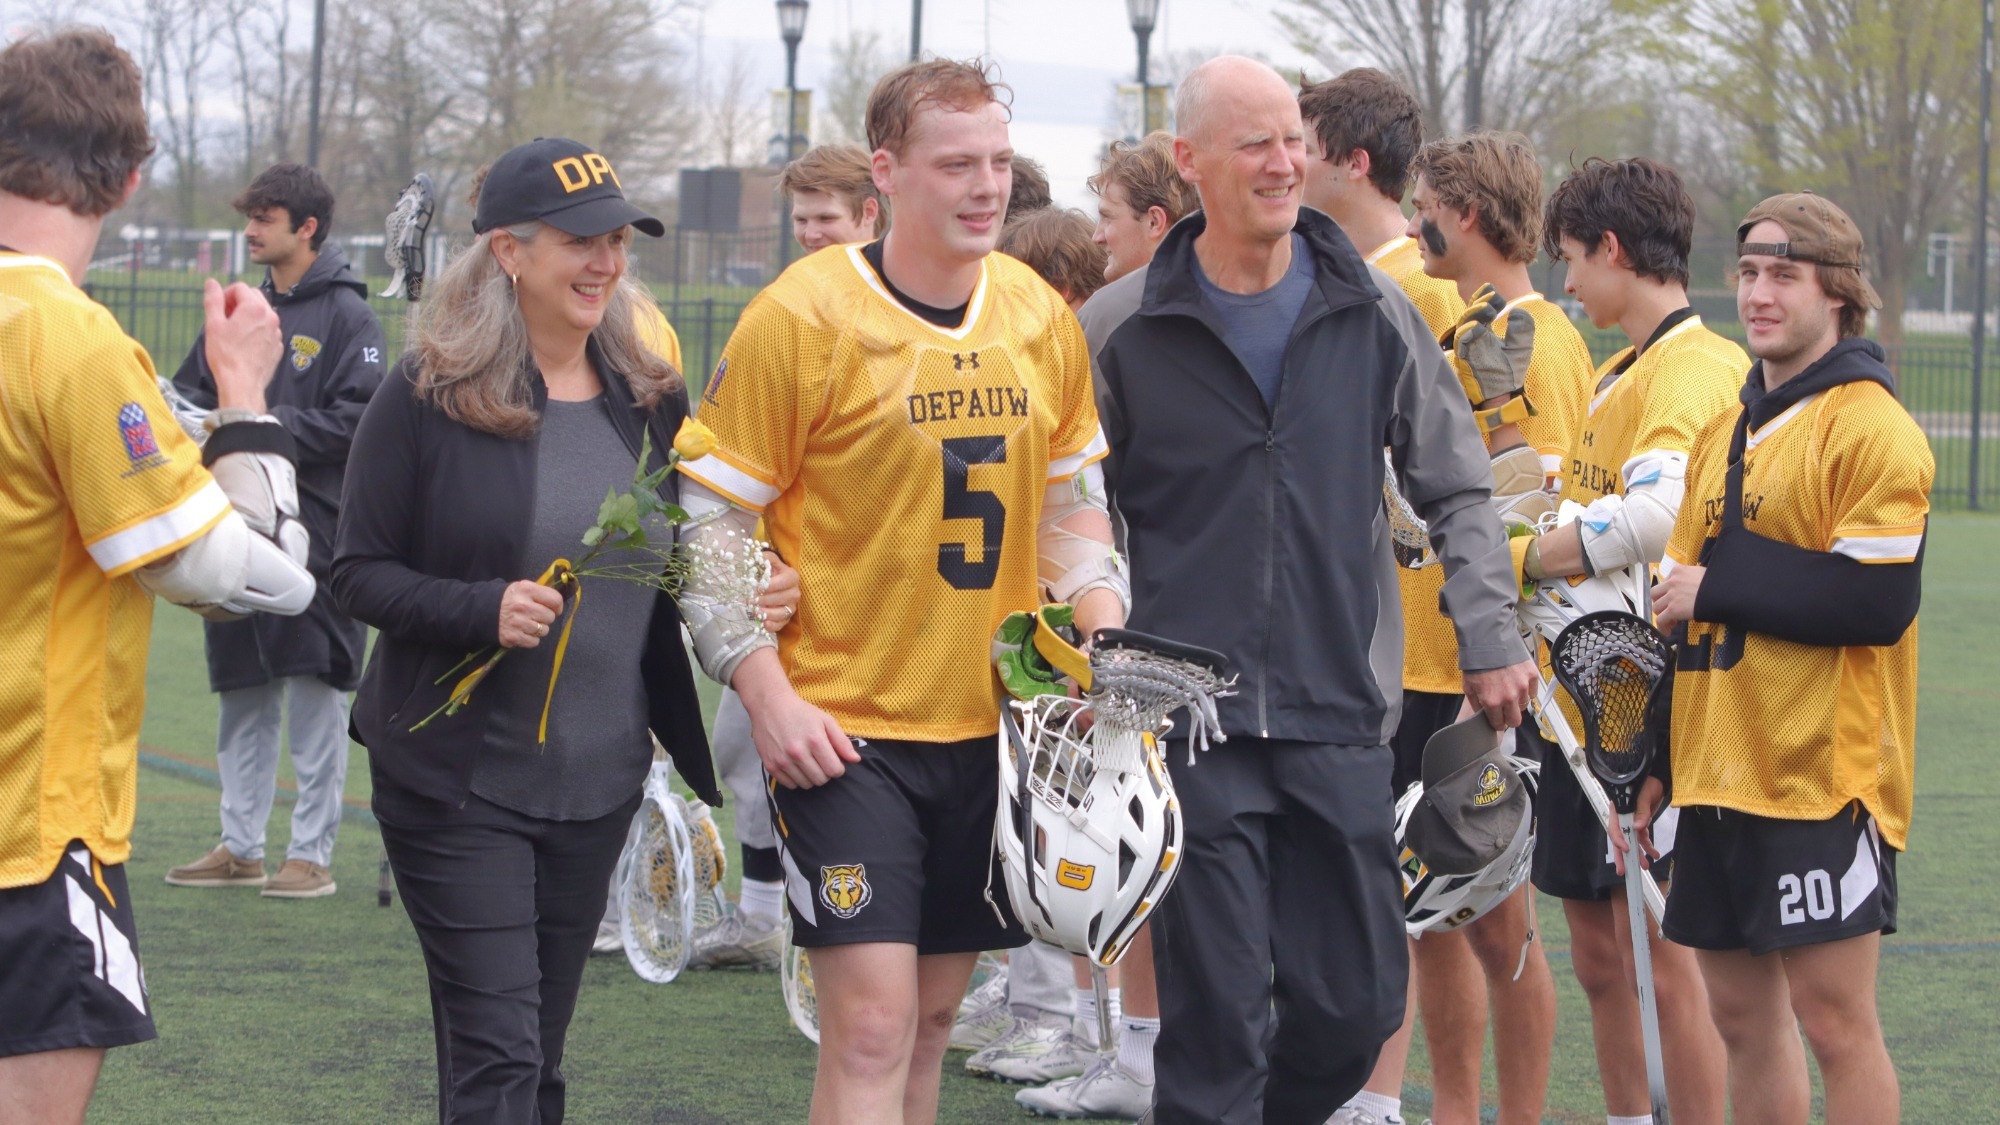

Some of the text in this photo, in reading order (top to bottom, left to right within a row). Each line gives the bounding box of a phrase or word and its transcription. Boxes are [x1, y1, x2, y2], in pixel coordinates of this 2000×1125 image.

[552, 153, 622, 194] DP
[363, 347, 379, 363] 12
[907, 387, 1028, 424] DEPAUW
[937, 435, 1006, 590] 5
[1445, 906, 1476, 928] 19
[1778, 869, 1835, 926] 20
